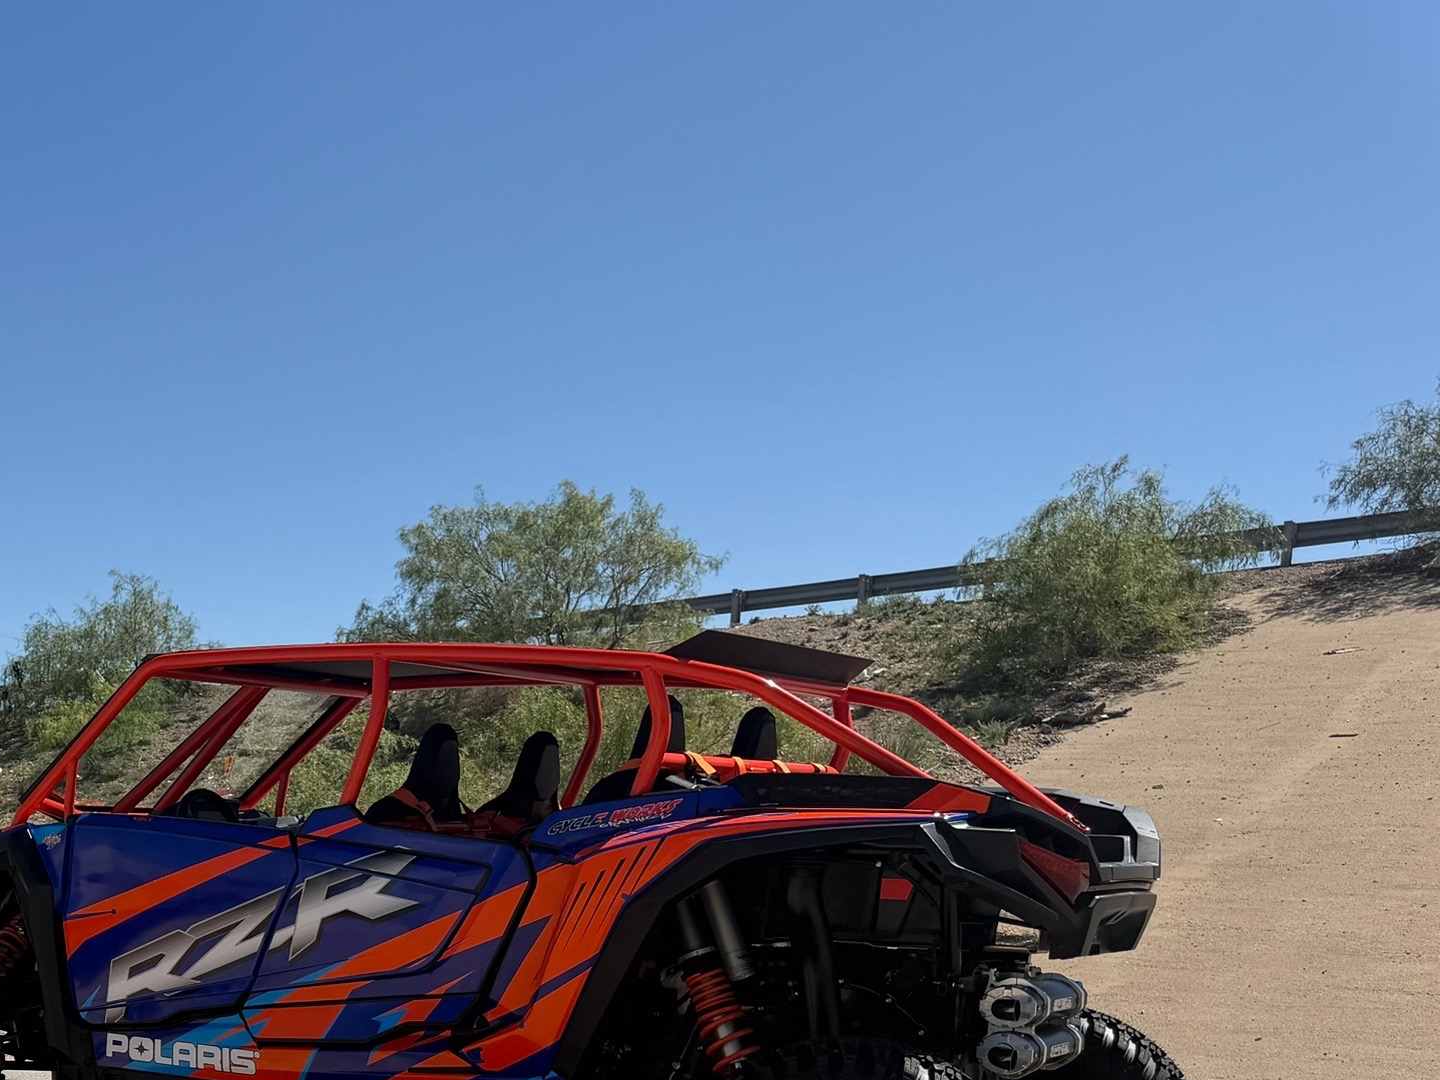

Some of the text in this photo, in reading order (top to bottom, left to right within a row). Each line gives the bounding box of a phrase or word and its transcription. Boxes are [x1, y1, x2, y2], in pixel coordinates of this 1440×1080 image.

[548, 798, 683, 835] CYCLE WORKS
[105, 846, 419, 1024] RZR
[105, 1032, 259, 1075] POLARIS
